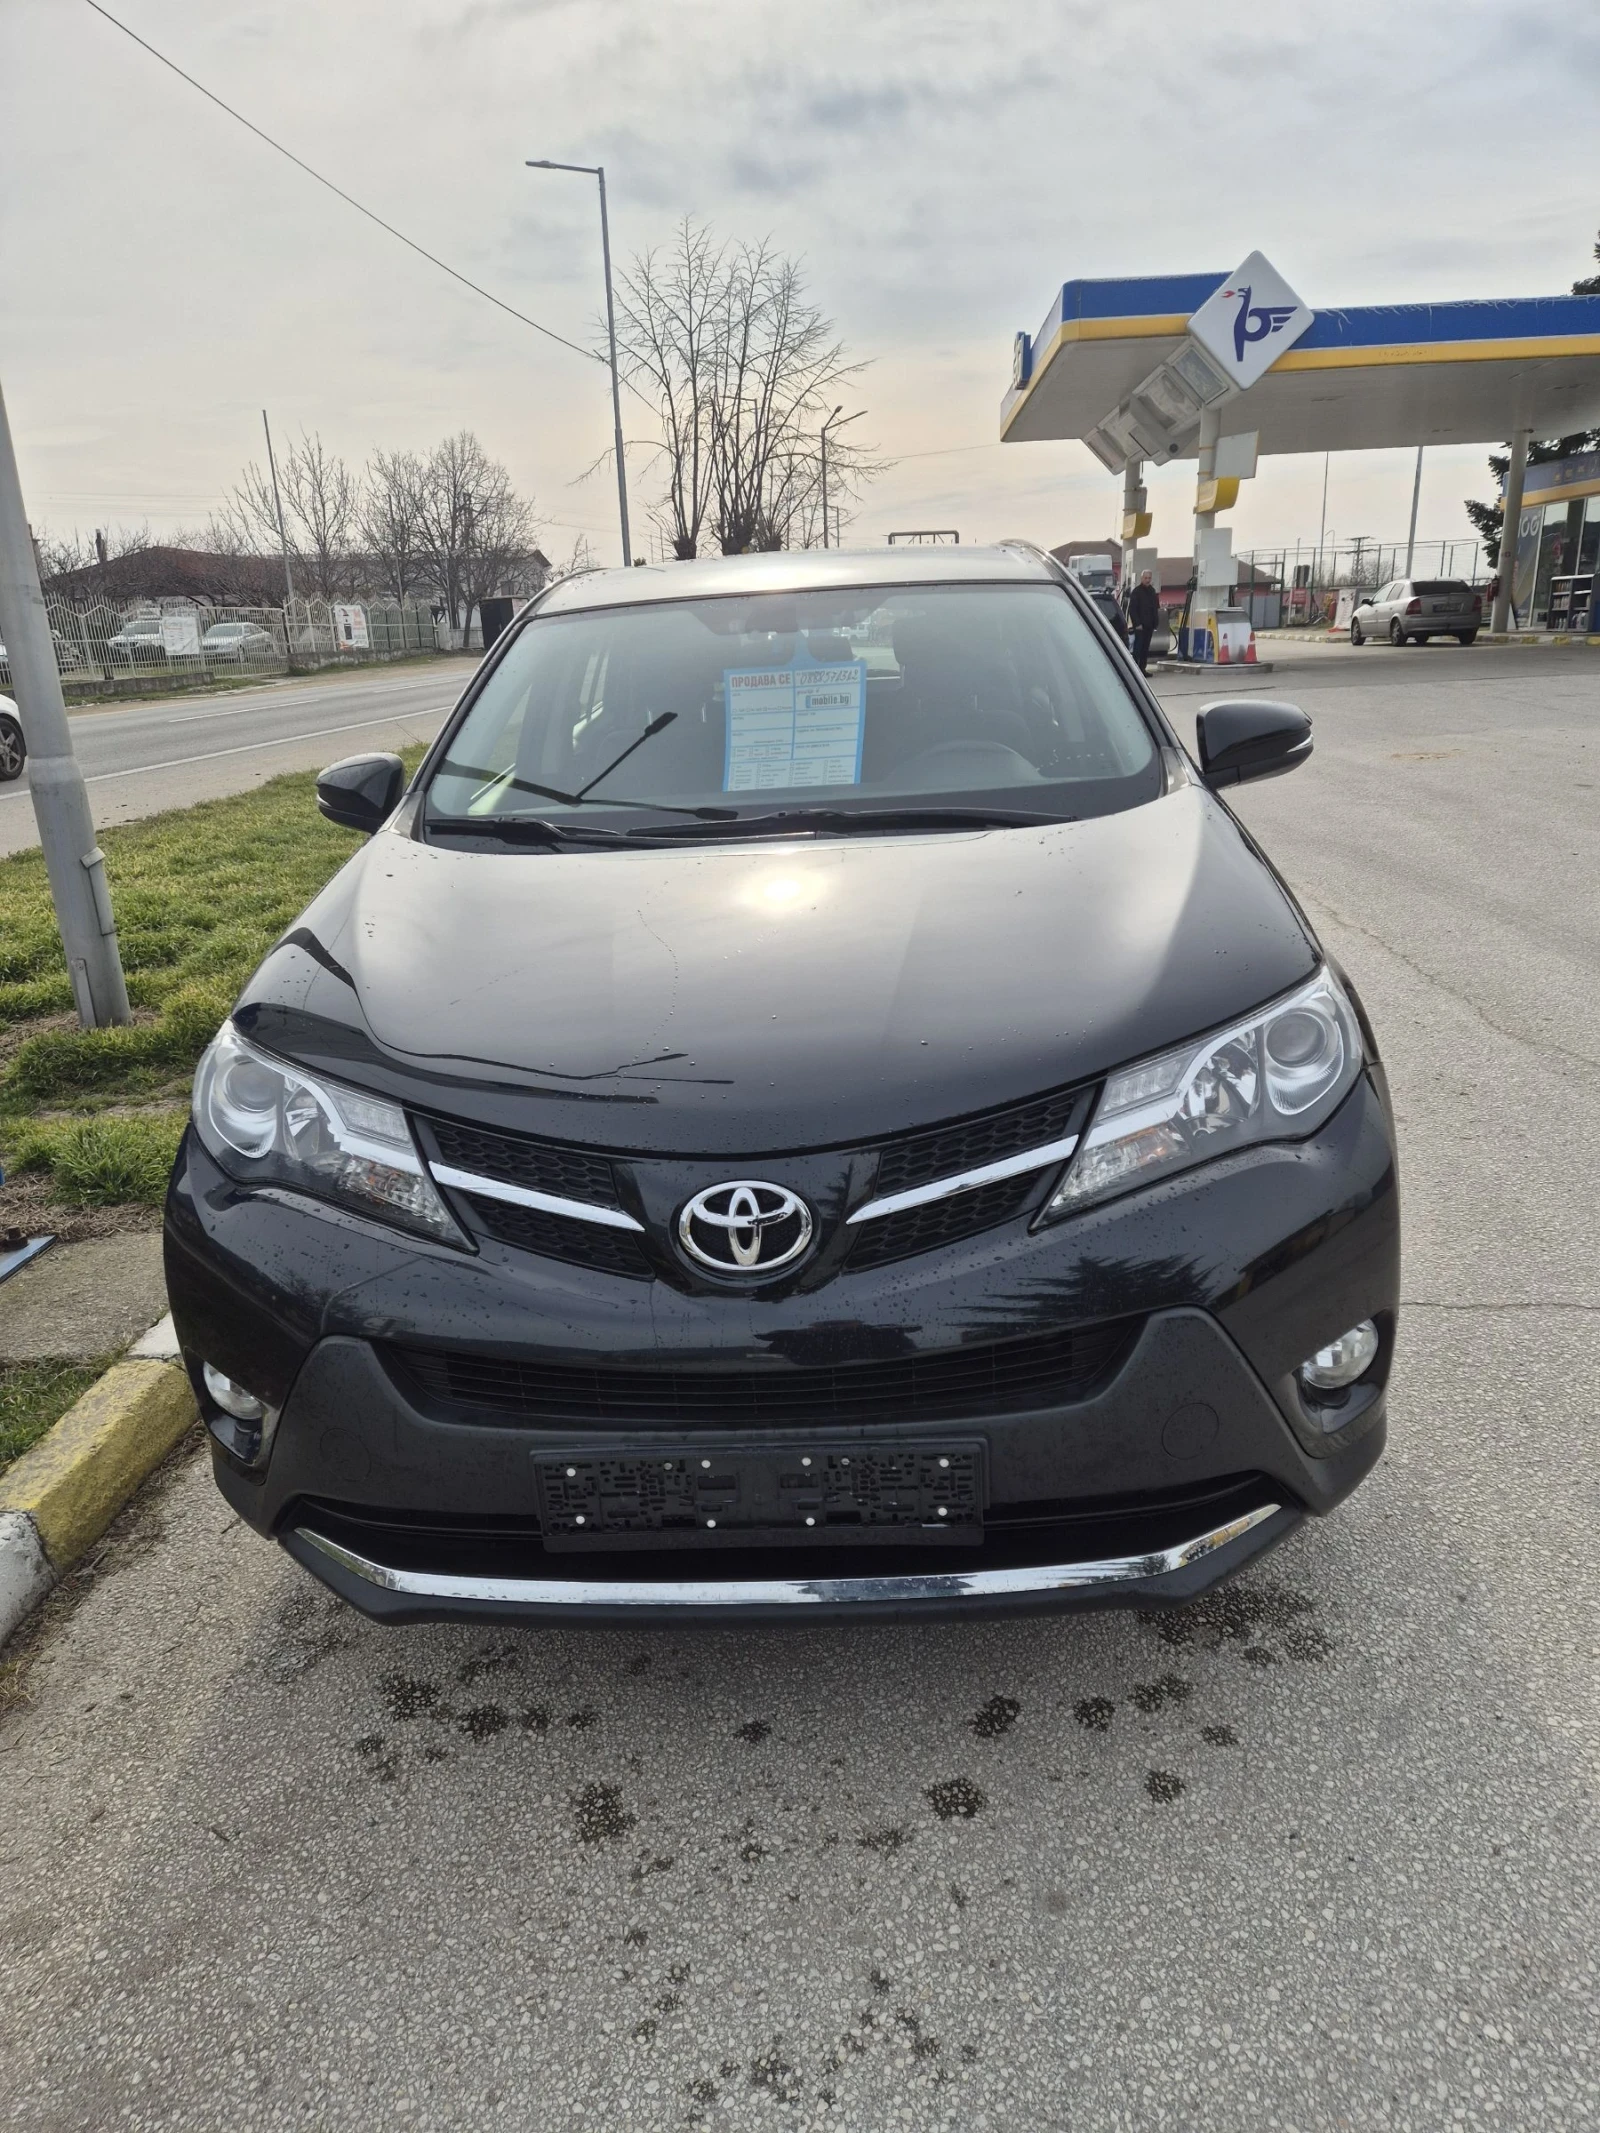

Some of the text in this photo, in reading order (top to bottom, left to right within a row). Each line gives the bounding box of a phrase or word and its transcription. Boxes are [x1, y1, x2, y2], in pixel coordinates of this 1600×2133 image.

[732, 674, 791, 688] ПРОДАВА СЕ
[811, 695, 850, 706] mobile.bg
